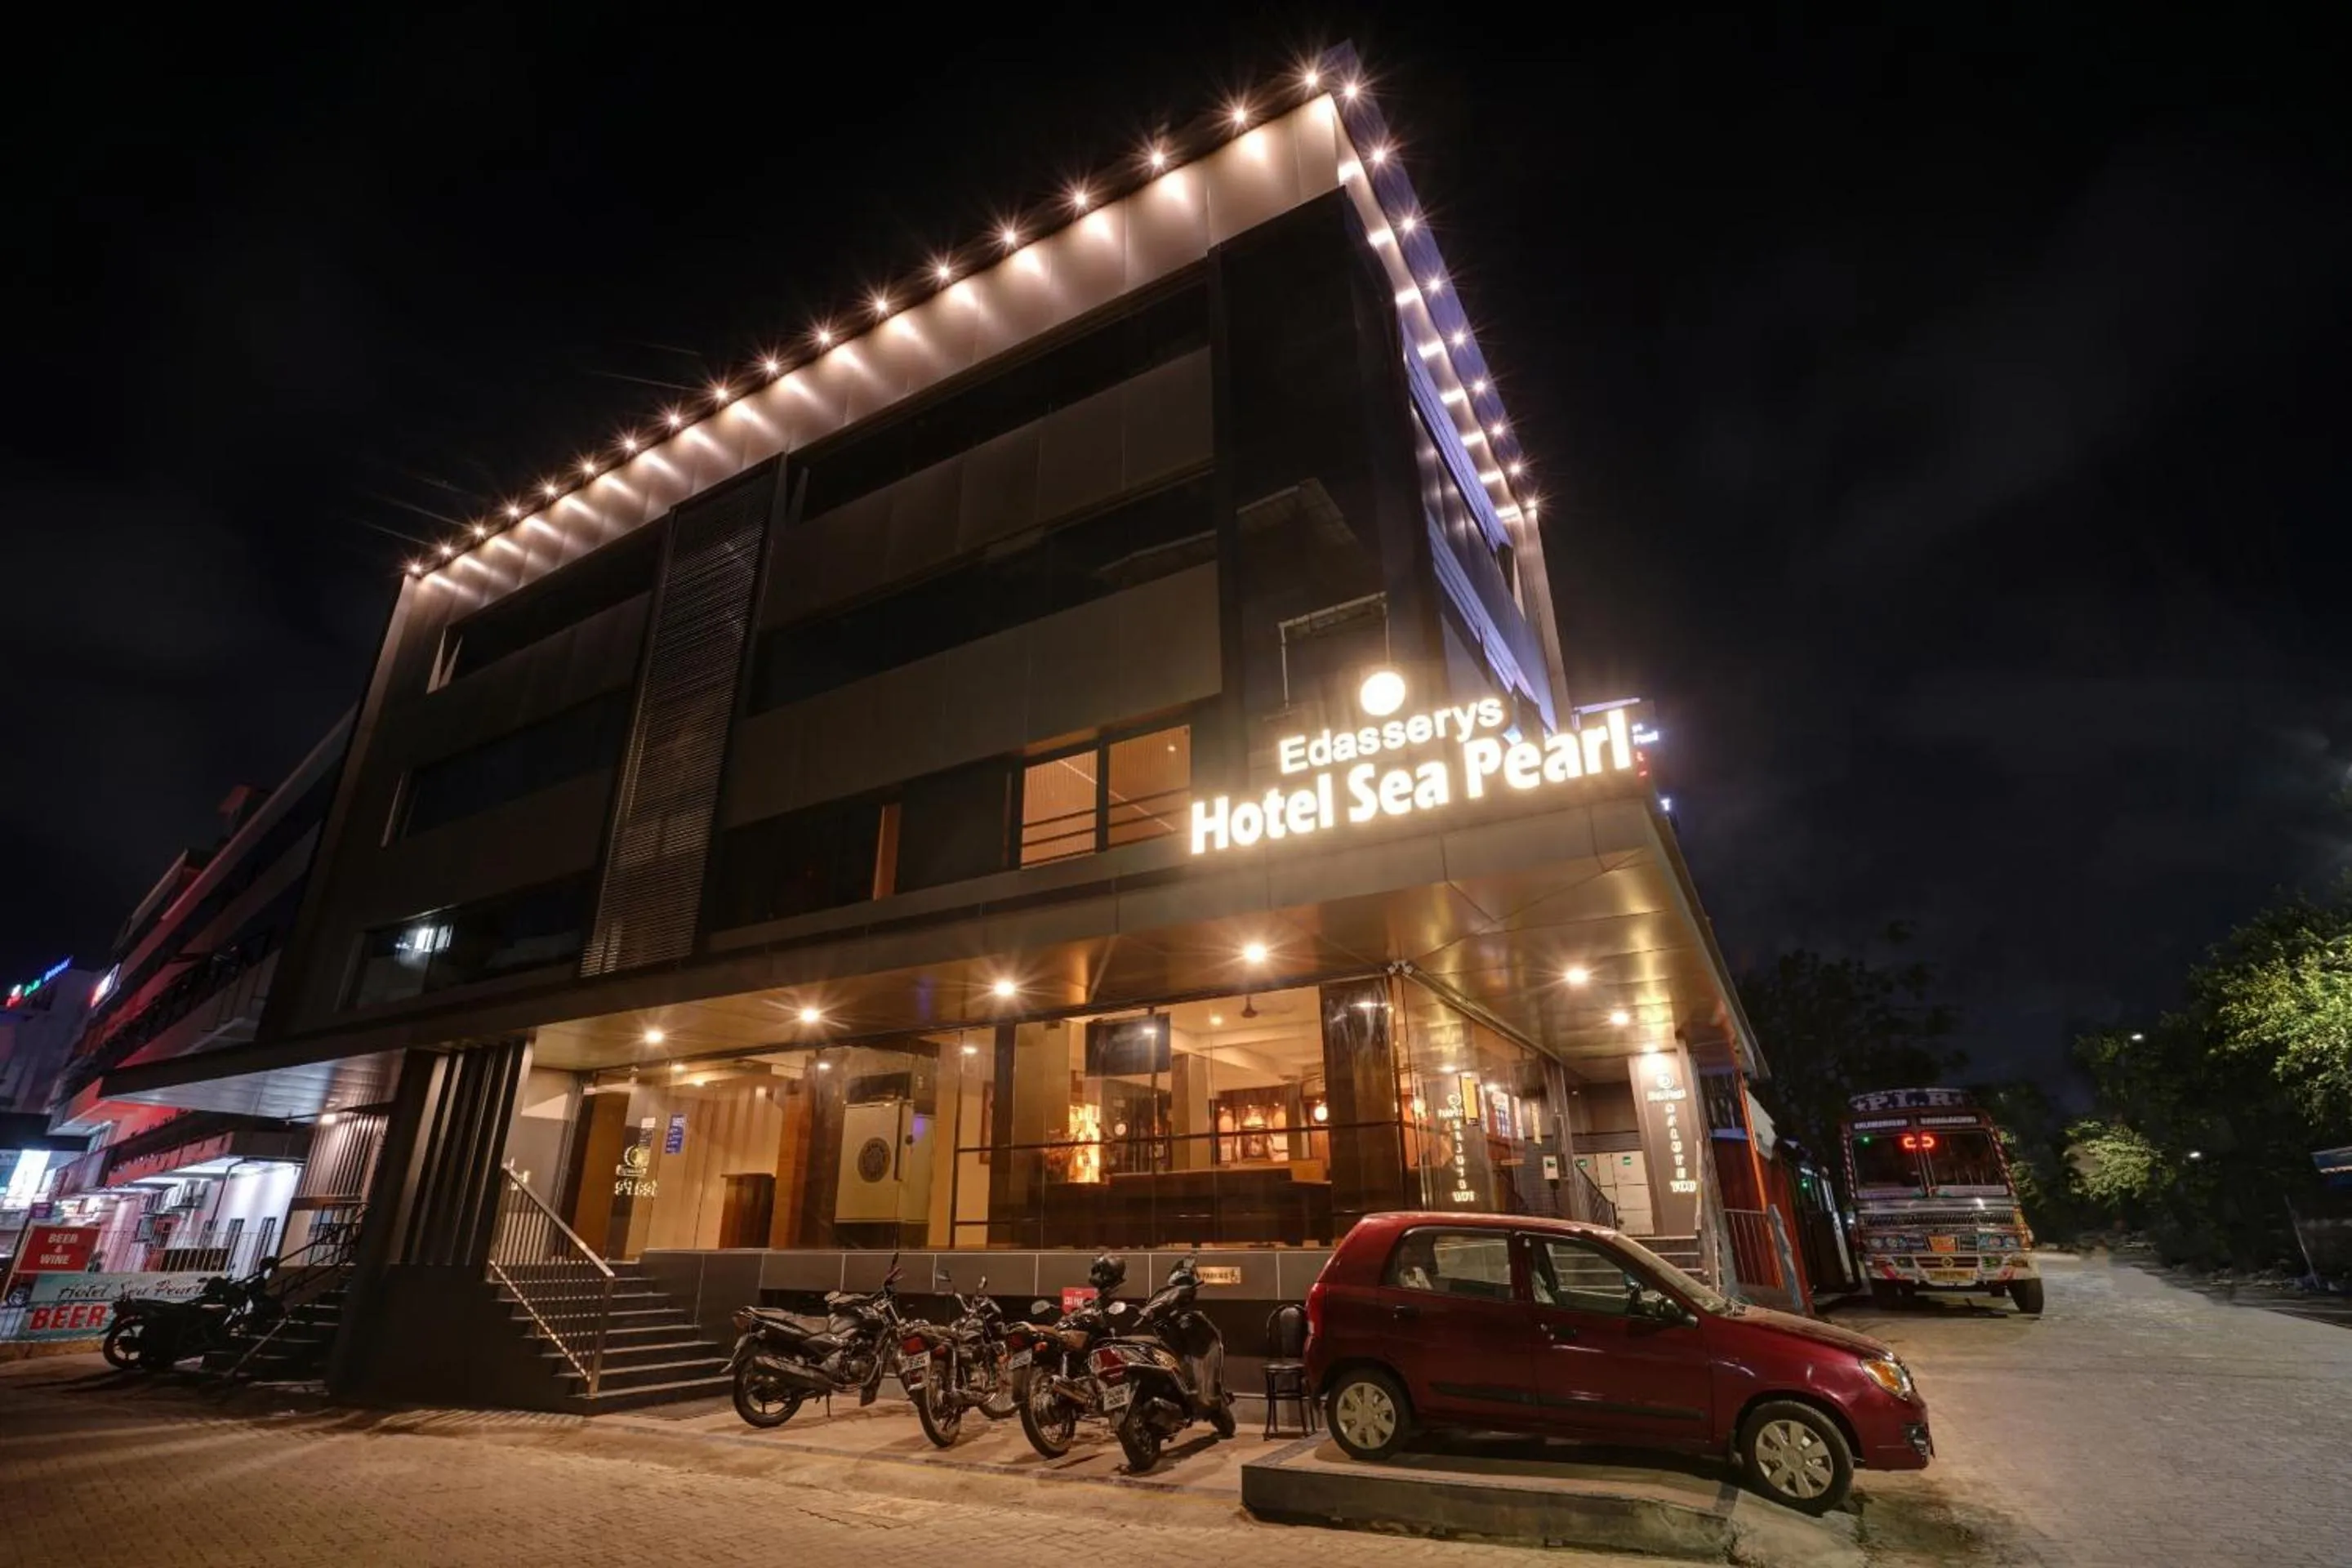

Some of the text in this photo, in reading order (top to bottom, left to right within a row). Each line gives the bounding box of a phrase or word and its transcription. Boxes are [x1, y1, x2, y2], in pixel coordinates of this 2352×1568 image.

[1279, 697, 1505, 774] Edasserys
[1191, 708, 1632, 854] Hotel Sea Pearl
[47, 1232, 79, 1245] BEER
[39, 1254, 70, 1265] WINE
[29, 1303, 109, 1330] BEER
